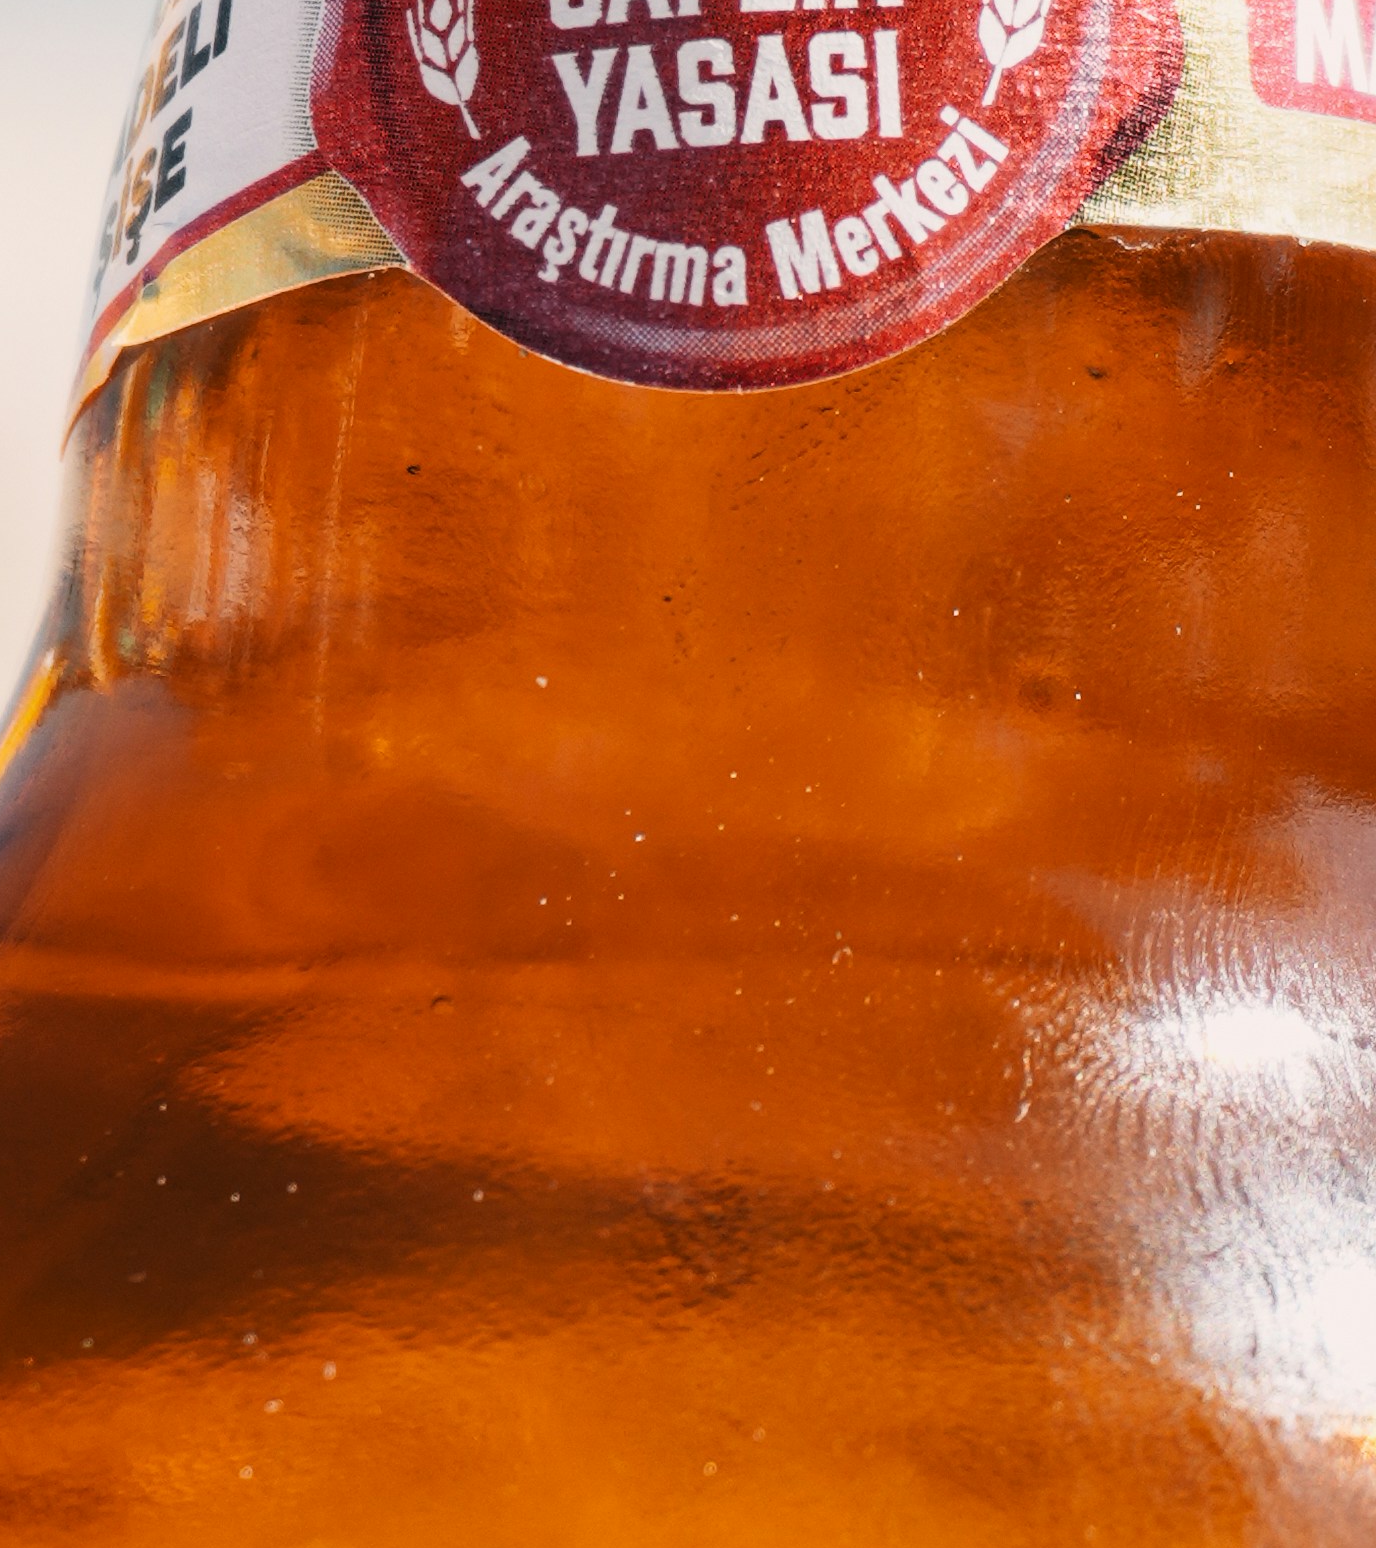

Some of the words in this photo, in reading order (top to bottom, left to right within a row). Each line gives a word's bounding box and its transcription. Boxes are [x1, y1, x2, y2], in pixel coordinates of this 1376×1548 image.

[552, 31, 904, 157] YASASI
[464, 136, 748, 306] Araştırma
[765, 106, 1010, 300] Merkezi
